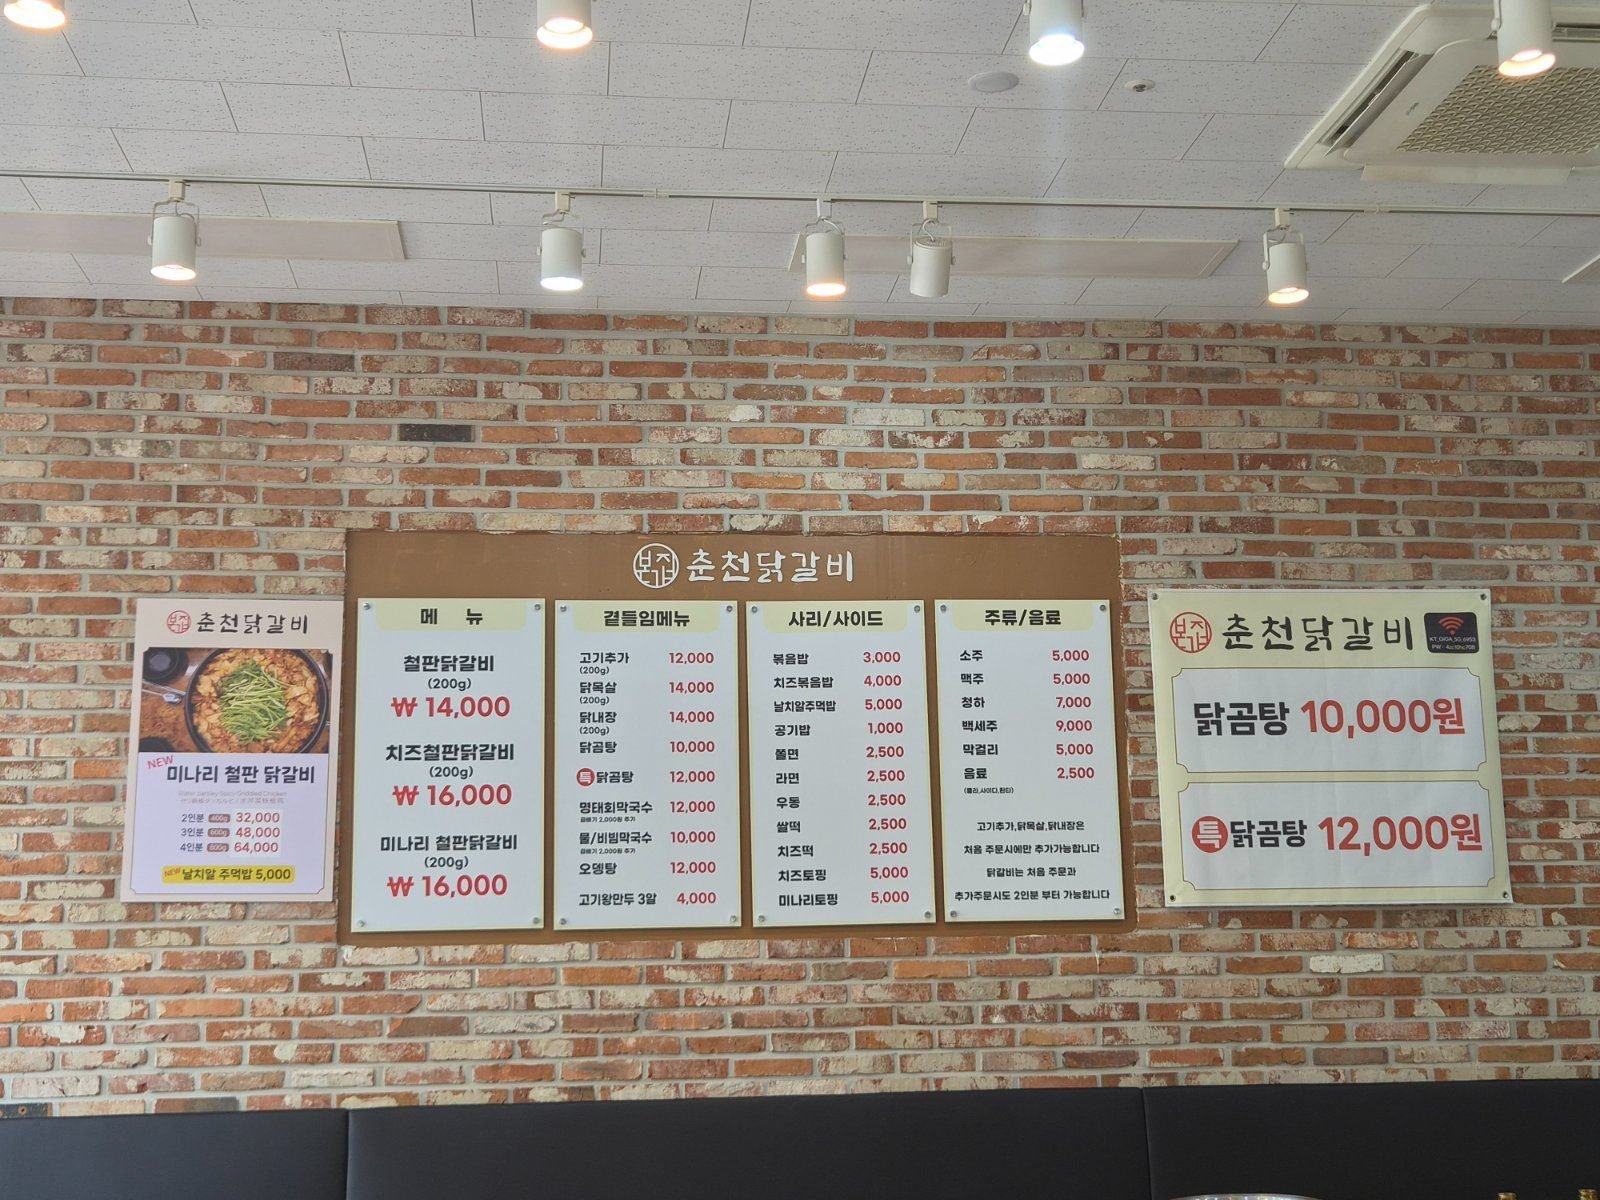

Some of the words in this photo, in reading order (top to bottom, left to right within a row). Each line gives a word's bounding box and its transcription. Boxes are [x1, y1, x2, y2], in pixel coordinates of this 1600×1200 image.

[686, 548, 853, 583] 춘천닭갈비
[197, 612, 308, 634] 춘천닭갈비
[604, 610, 690, 627] 곁들임메뉴
[788, 610, 884, 628] 사리/사이드
[984, 609, 1062, 626] 주류/음료
[1222, 613, 1413, 651] 춘천닭갈비
[580, 652, 630, 664] 고기추가
[669, 652, 714, 664] 12,000
[773, 654, 808, 665] 볶음밥
[863, 652, 900, 664] 3,000
[960, 650, 984, 662] 소주
[1052, 650, 1090, 662] 5,000
[404, 655, 494, 672] 철판닭갈비
[580, 666, 610, 676] (200g)
[428, 678, 472, 691] (200g)
[774, 677, 834, 688] 치즈볶음밥
[864, 675, 902, 687] 4,000
[960, 673, 984, 685] 맥주
[1053, 673, 1090, 685] 5,000
[580, 682, 617, 694] 닭목살
[669, 682, 714, 694] 14,000
[425, 696, 510, 718] 14,000
[580, 696, 610, 706] (200g)
[774, 701, 836, 712] 날치알주먹밥
[865, 698, 902, 710] 5,000
[962, 696, 986, 708] 청하
[1056, 696, 1092, 708] 7,000
[580, 712, 617, 724] 닭내장
[670, 712, 714, 724] 14,000
[1194, 701, 1290, 736] 닭곰탕
[1301, 698, 1465, 739] 10,000원
[580, 726, 610, 736] (200g)
[774, 724, 810, 736] 공기밥
[868, 722, 903, 734] 1,000
[962, 720, 998, 732] 백세주
[1056, 720, 1092, 732] 9,000
[386, 744, 514, 761] 치즈철판닭갈비
[580, 742, 617, 754] 닭곰탕
[670, 741, 715, 754] 10,000
[775, 748, 799, 760] 쫄면
[866, 746, 904, 758] 2,500
[962, 744, 998, 756] 막걸리
[1056, 743, 1094, 756] 5,000
[147, 755, 174, 769] NEW
[166, 766, 218, 783] 미나리
[224, 766, 259, 783] 철판
[264, 766, 315, 784] 닭갈비
[429, 766, 474, 780] (200g)
[596, 771, 634, 784] 닭곰탕
[670, 770, 716, 783] 12,000
[776, 772, 800, 784] 라면
[867, 770, 905, 782] 2,500
[964, 768, 988, 780] 음료
[1057, 767, 1094, 780] 2,500
[427, 784, 512, 807] 16,000
[776, 796, 800, 808] 우동
[868, 794, 906, 806] 2,500
[580, 801, 653, 814] 명태회막국수
[670, 801, 716, 813] 12,000
[182, 813, 204, 822] 2인분
[236, 812, 280, 824] 32,000
[776, 821, 800, 833] 쌀떡
[868, 818, 906, 830] 2,500
[181, 828, 204, 837] 3인분
[236, 827, 280, 839] 48,000
[580, 832, 652, 844] 물/비빔막국수
[670, 831, 716, 844] 10,000
[1194, 818, 1225, 851] 특
[1230, 819, 1307, 848] 닭곰탕
[1318, 813, 1483, 856] 12,000원
[180, 843, 203, 852] 4인분
[234, 842, 278, 854] 64,000
[380, 836, 430, 852] 미나리
[435, 834, 518, 850] 철판닭갈비
[778, 845, 814, 858] 치즈떡
[870, 842, 908, 855] 2,500
[964, 845, 982, 855] 처음
[986, 844, 1032, 854] 주문시에만
[1034, 844, 1100, 854] 추가가능합니다
[424, 856, 469, 870] (200g)
[579, 862, 617, 875] 오뎅탕
[670, 862, 716, 874] 12,000
[164, 868, 182, 878] NEW
[182, 868, 215, 881] 날치알
[219, 868, 250, 880] 주먹밥
[256, 868, 290, 882] 5,000
[778, 870, 826, 882] 치즈토핑
[870, 866, 908, 880] 5,000
[986, 868, 1024, 878] 닭갈비는
[1026, 867, 1046, 878] 처음
[1048, 866, 1076, 877] 주문과
[422, 874, 508, 898] 16,000
[579, 893, 635, 906] 고기왕만두
[638, 892, 657, 905] 3알
[676, 892, 716, 904] 4,000
[778, 894, 838, 906] 미나리토핑
[871, 891, 910, 904] 5,000
[954, 891, 1012, 902] 추가주문시도
[1014, 890, 1039, 900] 2인분
[1042, 890, 1060, 900] 부터
[1063, 889, 1110, 900] 가능합니다
